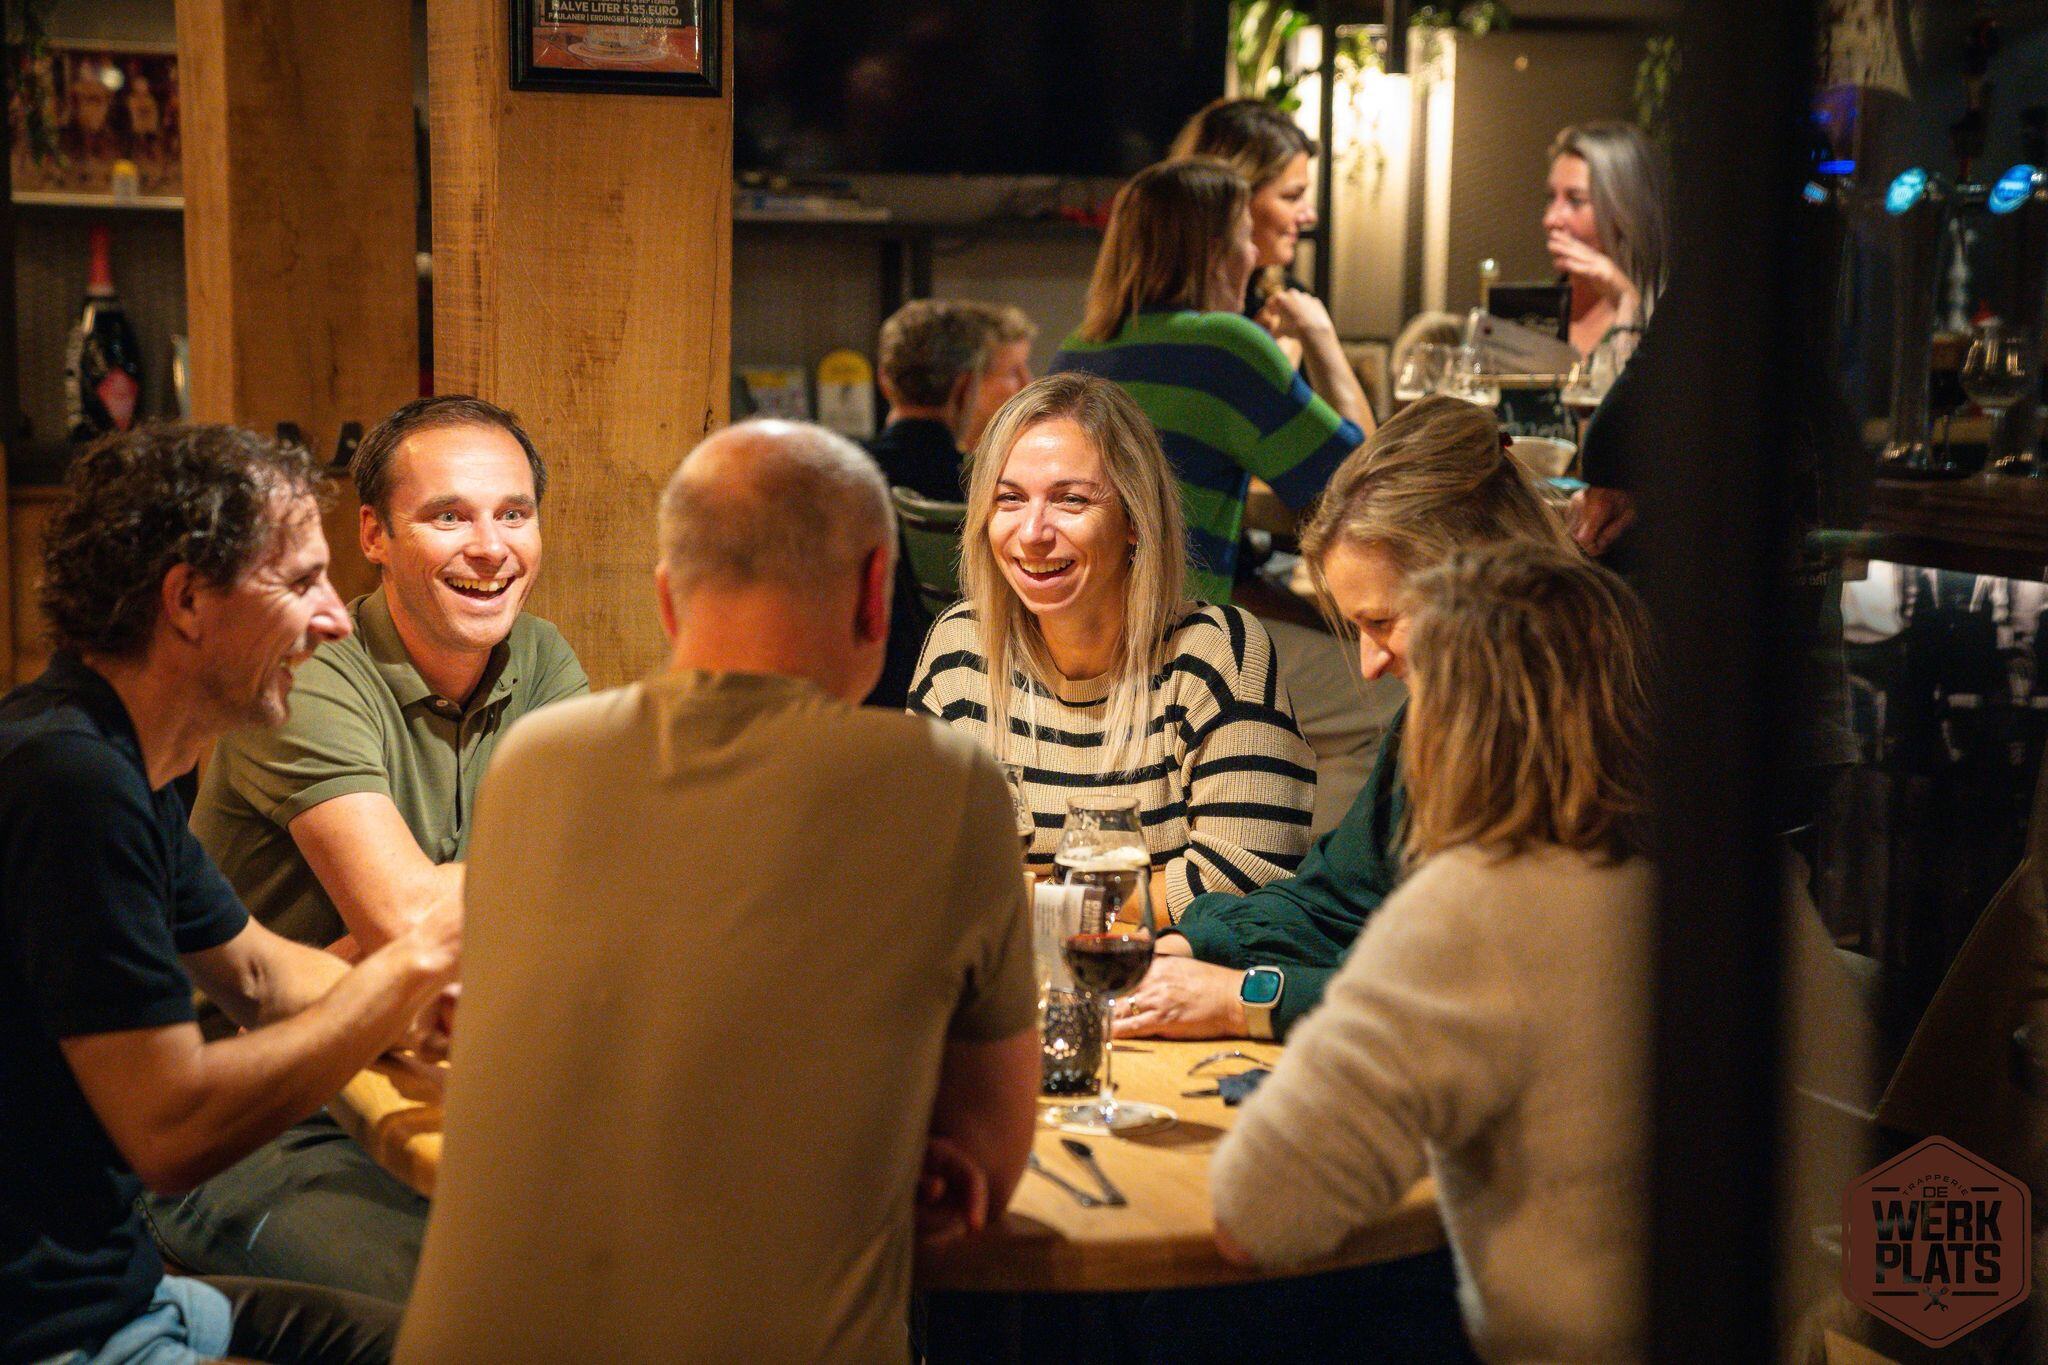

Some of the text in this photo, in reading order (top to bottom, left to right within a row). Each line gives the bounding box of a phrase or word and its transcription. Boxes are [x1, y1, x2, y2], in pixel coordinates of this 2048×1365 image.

[592, 2, 620, 13] LITER
[648, 5, 679, 16] EURO
[548, 12, 586, 21] PAULANER
[591, 14, 625, 23] ERDINGER
